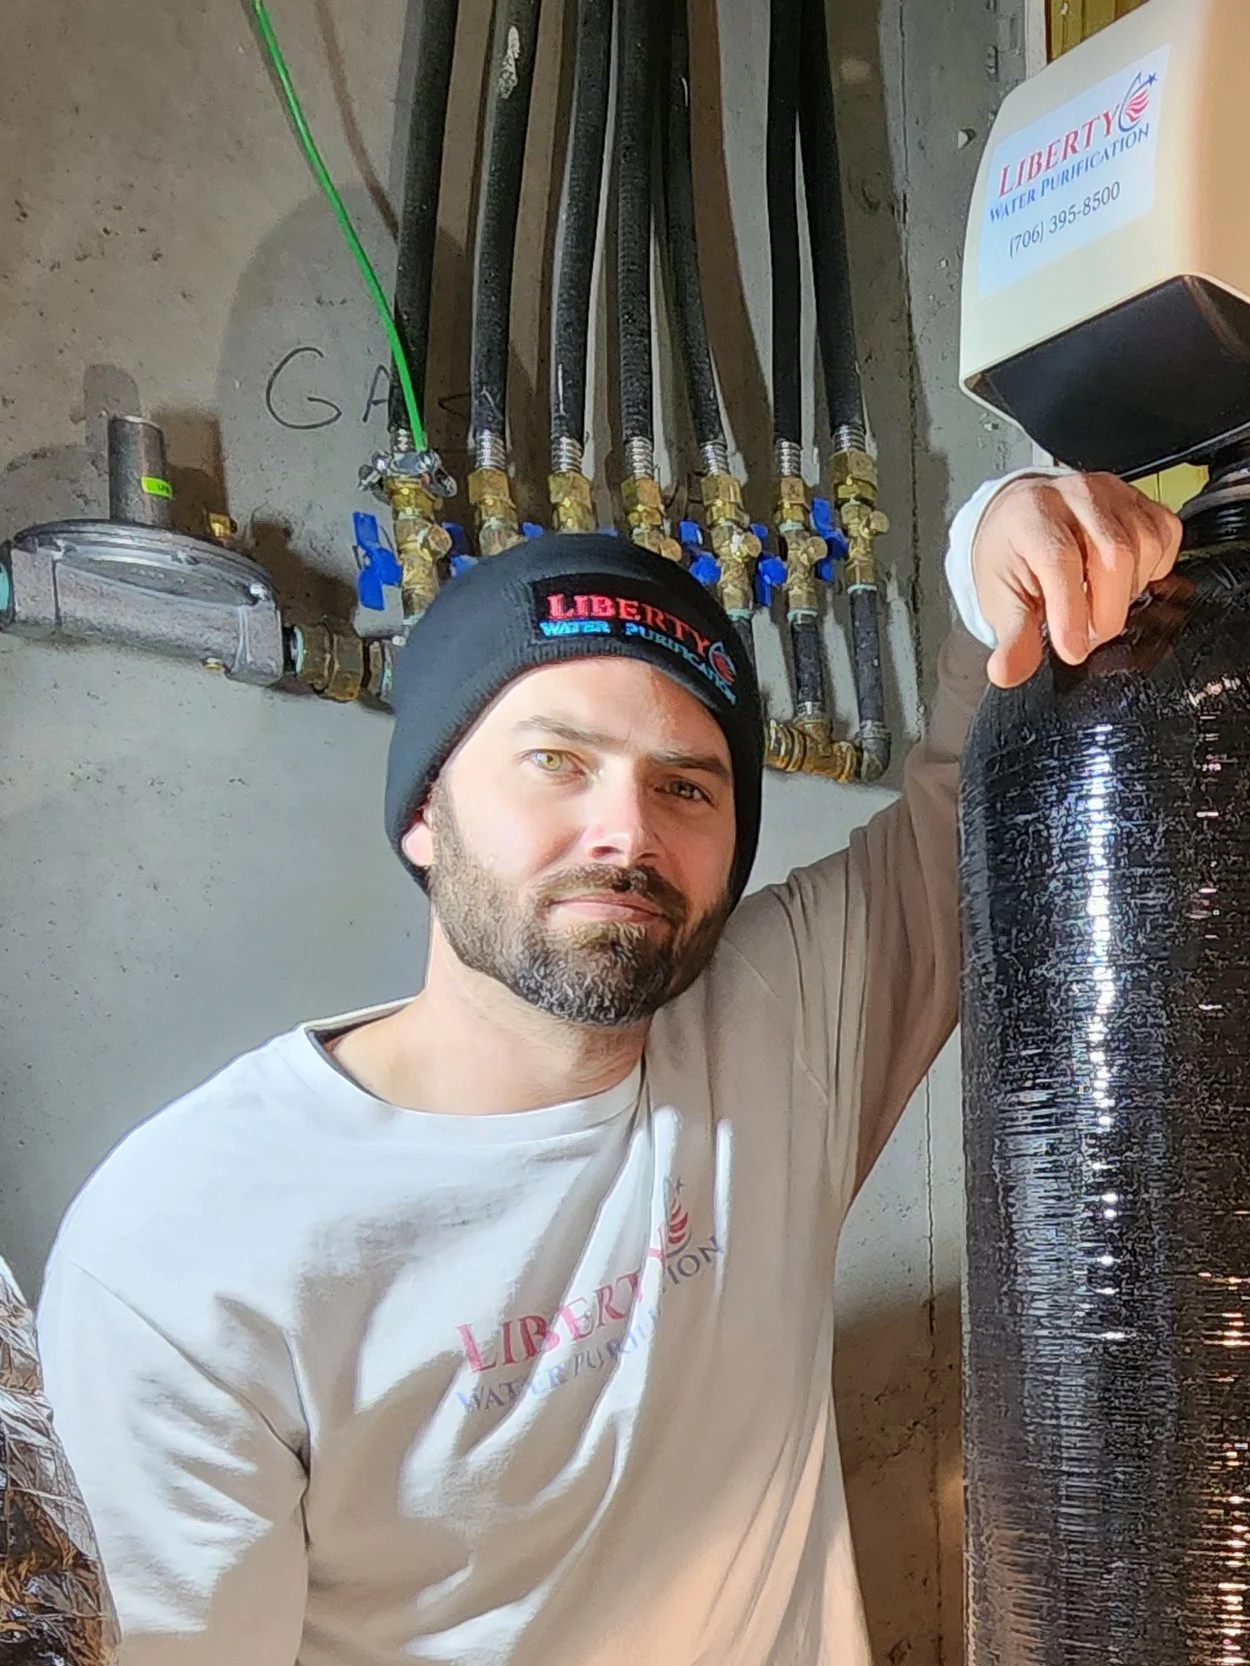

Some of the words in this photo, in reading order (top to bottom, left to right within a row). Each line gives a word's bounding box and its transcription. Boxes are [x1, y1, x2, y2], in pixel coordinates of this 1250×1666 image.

[990, 187, 1036, 223] WATER
[1041, 123, 1149, 197] PURIFICATION
[998, 105, 1119, 197] LIBERTY
[1009, 221, 1044, 258] (706)
[1049, 181, 1120, 234] 395-8500
[266, 346, 471, 430] GA
[539, 621, 610, 637] WATER
[625, 623, 737, 705] PURIFICATION
[547, 594, 711, 658] LIBERTY
[455, 1223, 667, 1374] LIBERTY
[455, 1364, 567, 1412] WATER
